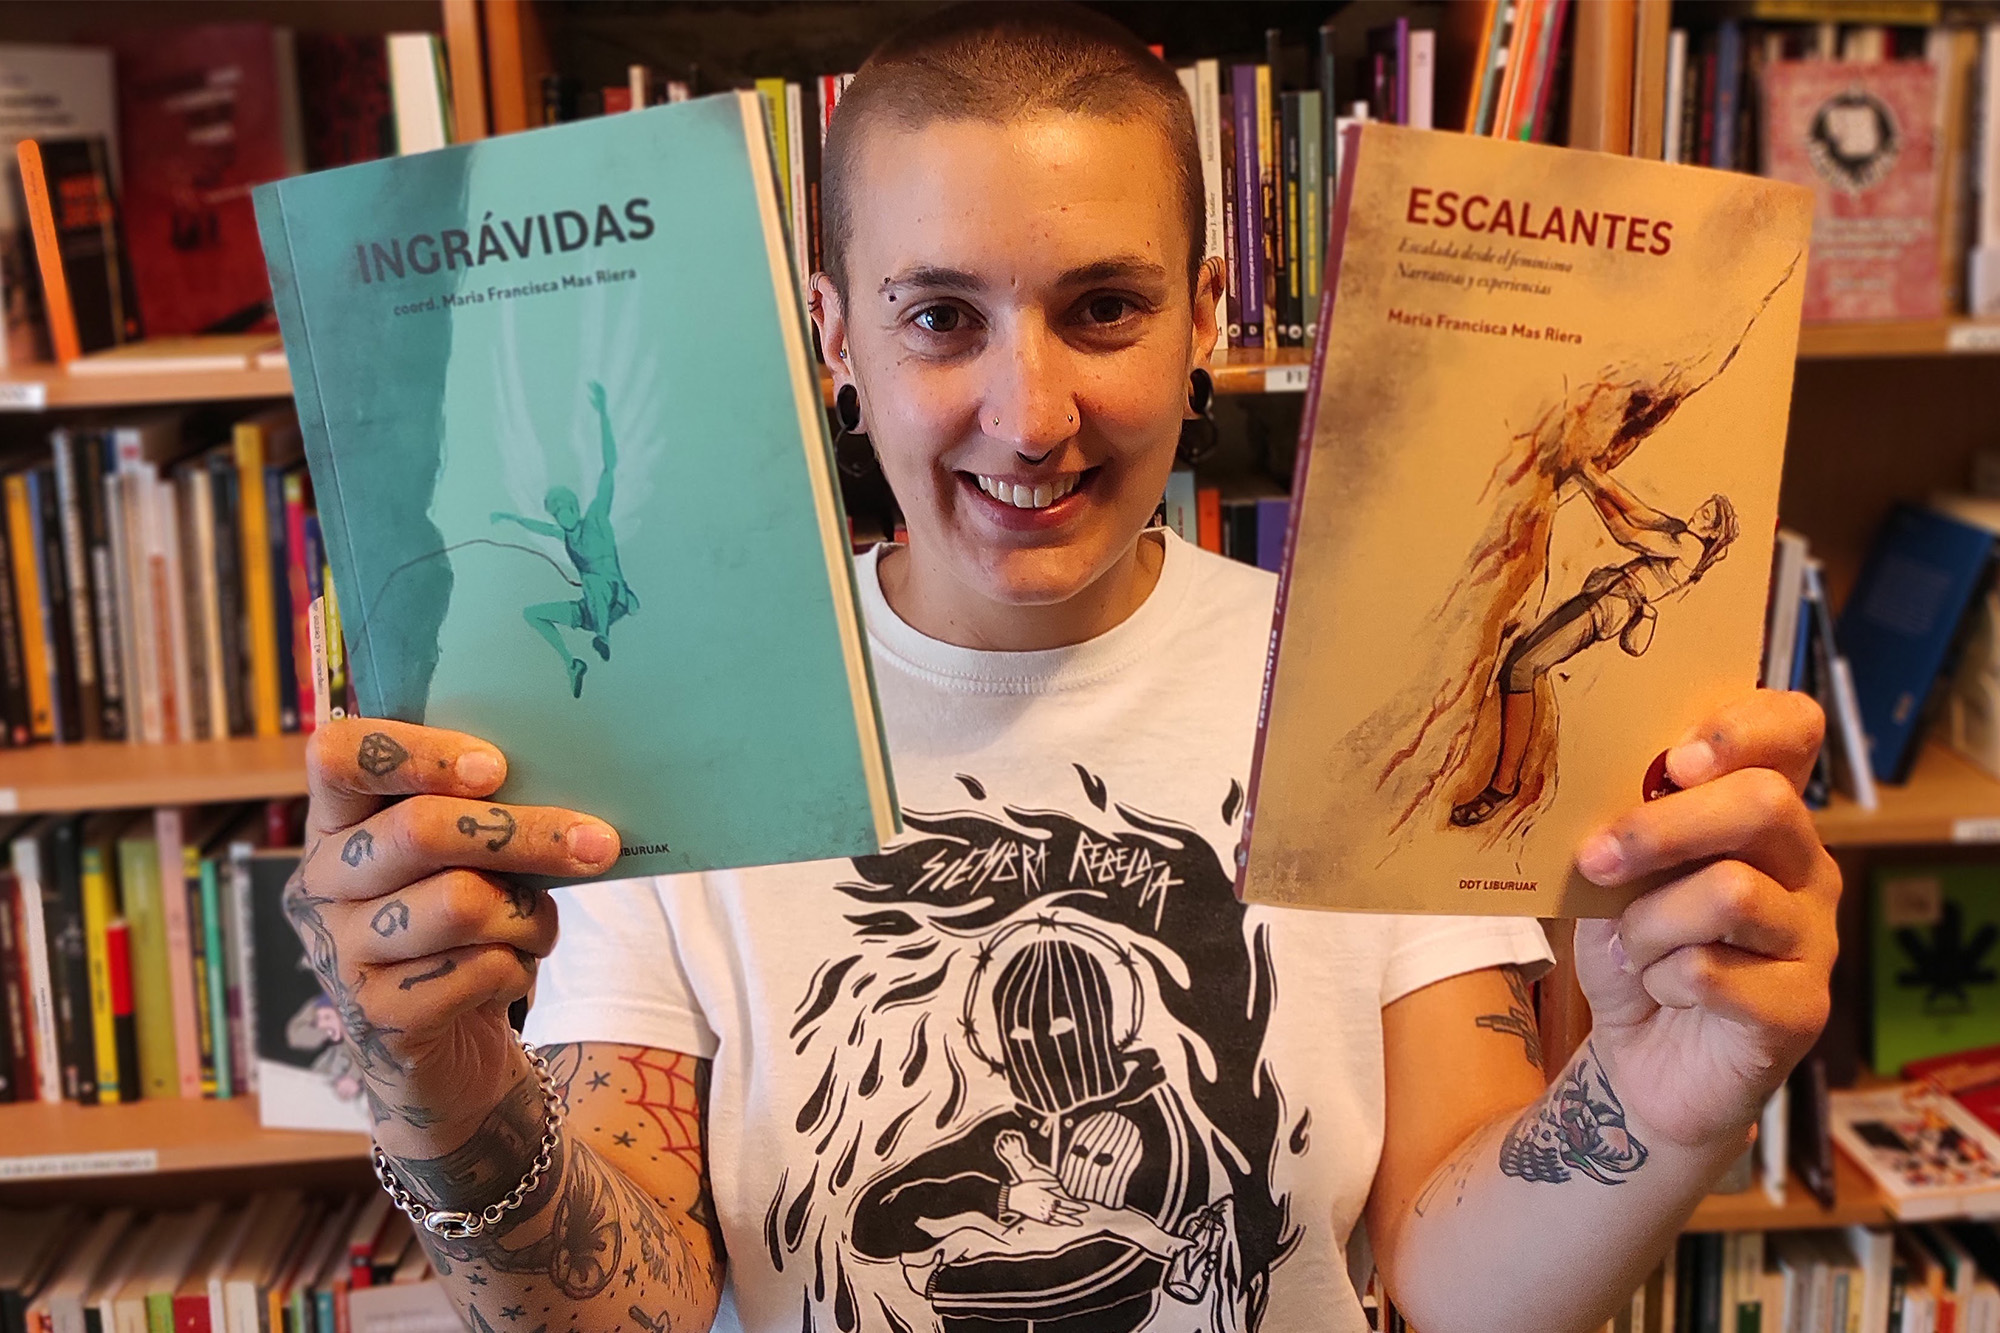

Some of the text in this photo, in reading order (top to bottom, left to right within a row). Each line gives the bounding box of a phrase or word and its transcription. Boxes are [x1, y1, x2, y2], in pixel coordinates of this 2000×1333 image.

[355, 197, 656, 285] INGRÁVIDAS
[1406, 187, 1674, 257] ESCALANTES
[1399, 237, 1573, 274] Escalada desde el feminismo
[393, 297, 440, 317] coord.
[487, 280, 558, 301] Francisca
[562, 275, 593, 291] Mas
[596, 266, 637, 285] Riera
[1396, 261, 1552, 296] Narrativas y experiencias
[1436, 314, 1507, 336] Francisca
[1511, 324, 1541, 341] Mas
[1544, 328, 1583, 345] Riera
[1257, 629, 1277, 729] ESCALANTES
[620, 843, 670, 858] IBURUAK
[906, 836, 1050, 896] SIEMBRA
[1459, 879, 1538, 892] DDT LIBURUAK
